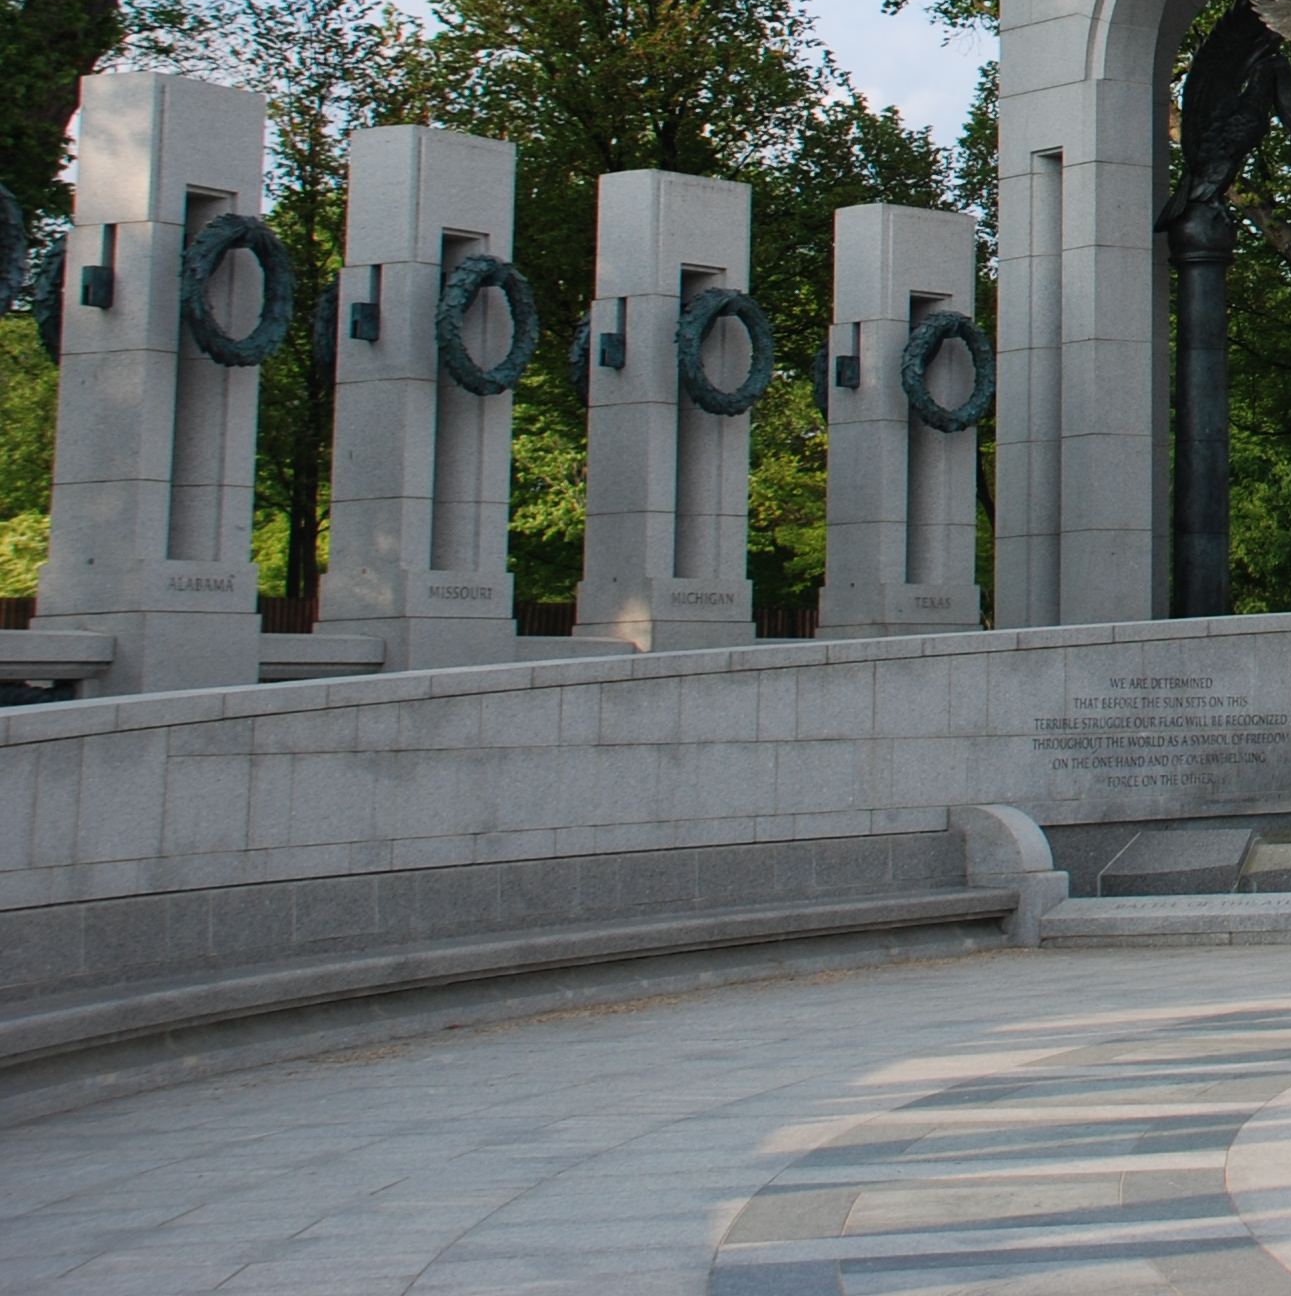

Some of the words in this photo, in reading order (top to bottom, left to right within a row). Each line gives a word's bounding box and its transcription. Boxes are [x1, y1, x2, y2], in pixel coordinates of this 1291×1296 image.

[169, 576, 235, 592] ALABAMA
[428, 586, 493, 600] MISSOURI
[671, 592, 734, 605] MICHIGAN
[914, 597, 951, 609] TEXAS
[1110, 678, 1126, 689] WE
[1129, 678, 1147, 689] ARE
[1150, 677, 1213, 689] DETERMINED
[1073, 697, 1099, 709] THAT
[1101, 697, 1138, 709] BEFORE
[1141, 696, 1160, 709] THE
[1163, 696, 1183, 708] SUN
[1186, 696, 1206, 708] SETS
[1208, 696, 1224, 708] ON
[1227, 695, 1248, 707] THIS
[1034, 717, 1080, 730] TERRIBLE
[1081, 716, 1131, 730] STRUGGLE
[1133, 716, 1157, 729] OUR
[1159, 715, 1183, 728] FLAG
[1185, 715, 1208, 727] WILL
[1211, 715, 1223, 727] BE
[1225, 713, 1288, 726] RECOGNIZED
[1032, 736, 1103, 750] THROUGHOUT
[1106, 736, 1125, 749] THE
[1127, 735, 1164, 748] WORLD
[1167, 735, 1179, 747] AS
[1182, 735, 1190, 747] A
[1190, 734, 1230, 747] SYMBOL
[1231, 733, 1246, 745] OF
[1052, 757, 1069, 770] ON
[1071, 757, 1090, 770] THE
[1092, 756, 1114, 769] ONE
[1115, 756, 1146, 768] HAND
[1147, 755, 1170, 767] AND
[1171, 754, 1185, 766] OF
[1107, 775, 1139, 788] FORCE
[1141, 775, 1157, 787] ON
[1160, 773, 1180, 786] THE
